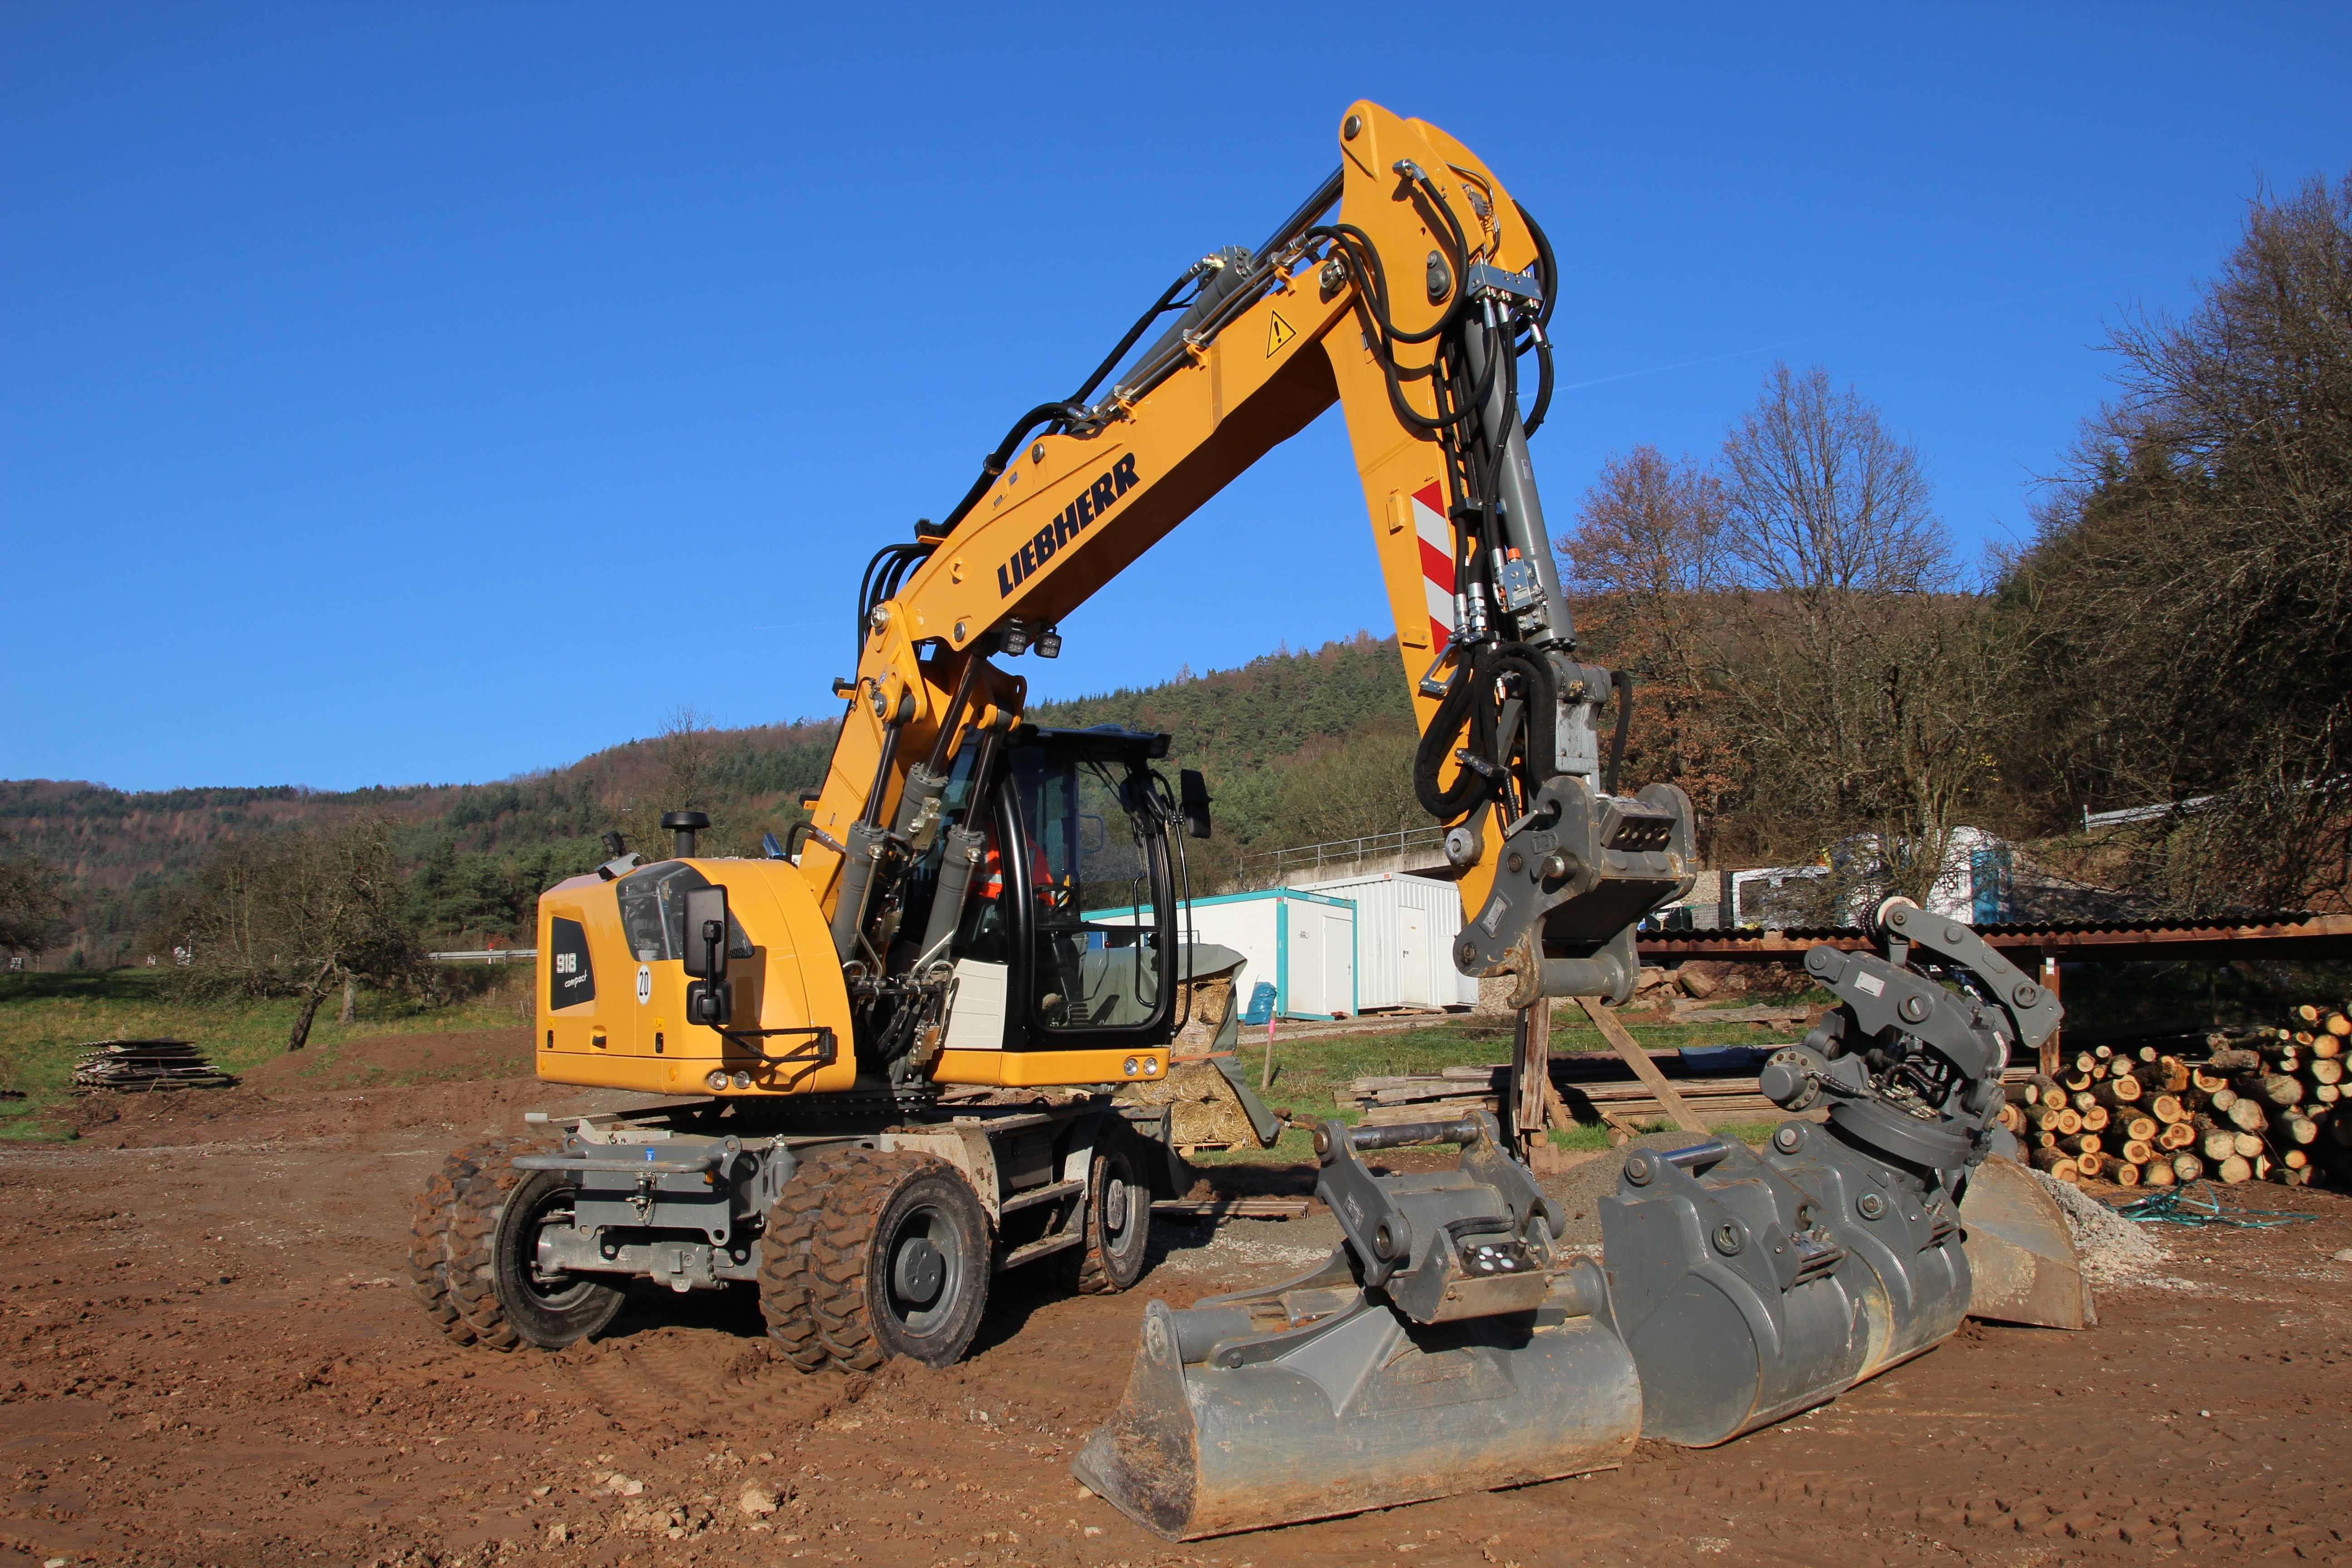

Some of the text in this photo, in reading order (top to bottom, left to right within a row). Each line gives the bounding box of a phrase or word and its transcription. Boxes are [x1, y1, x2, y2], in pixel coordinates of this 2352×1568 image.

[997, 452, 1141, 600] LIEBHERR
[557, 953, 577, 973] 918
[564, 970, 588, 988] compact
[639, 971, 649, 996] 20
